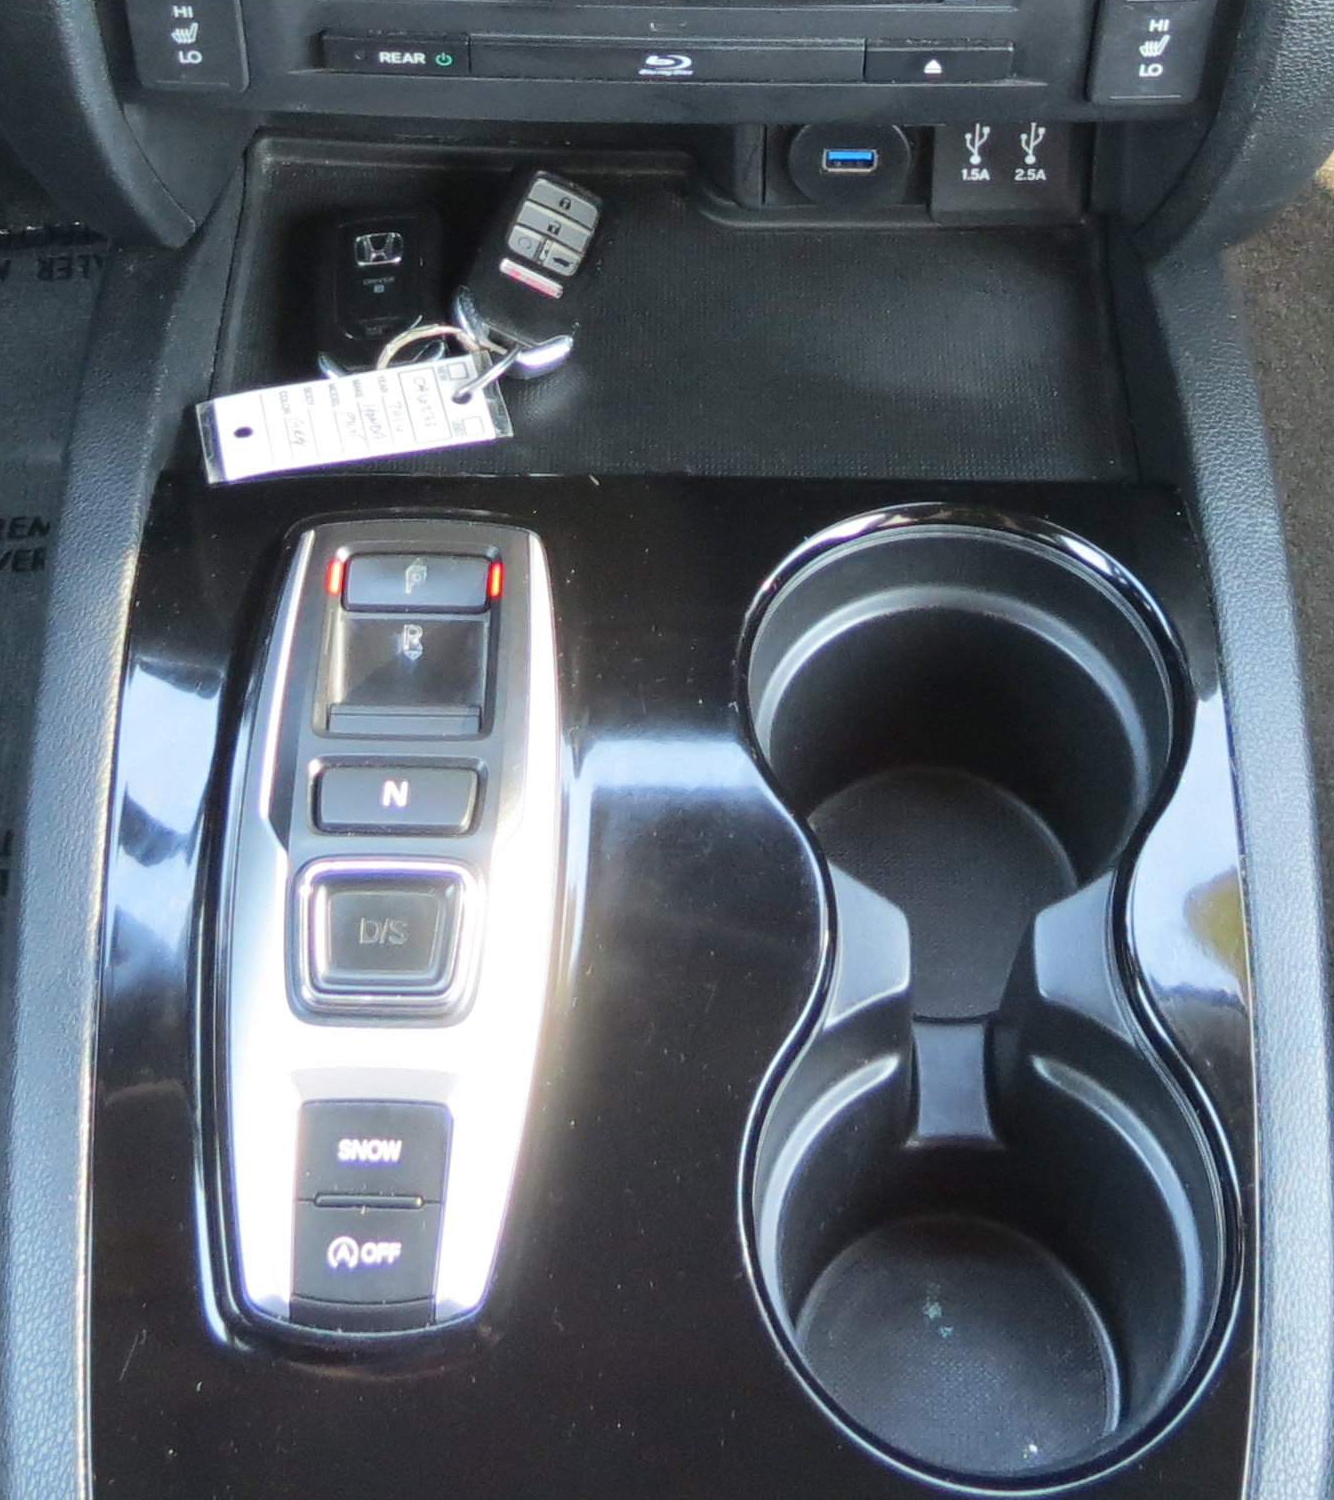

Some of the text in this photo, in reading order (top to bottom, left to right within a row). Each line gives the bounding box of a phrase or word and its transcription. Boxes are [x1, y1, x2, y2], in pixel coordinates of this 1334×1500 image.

[172, 4, 194, 19] HI
[1148, 18, 1170, 33] HI
[178, 50, 203, 65] LO
[378, 50, 426, 66] REAR
[1139, 62, 1164, 78] LO
[961, 168, 991, 182] 1.5A
[1014, 168, 1047, 182] 2.5A
[383, 781, 408, 807] N
[359, 917, 409, 947] D/S
[337, 1138, 402, 1162] SNOW
[360, 1241, 402, 1265] OFF
